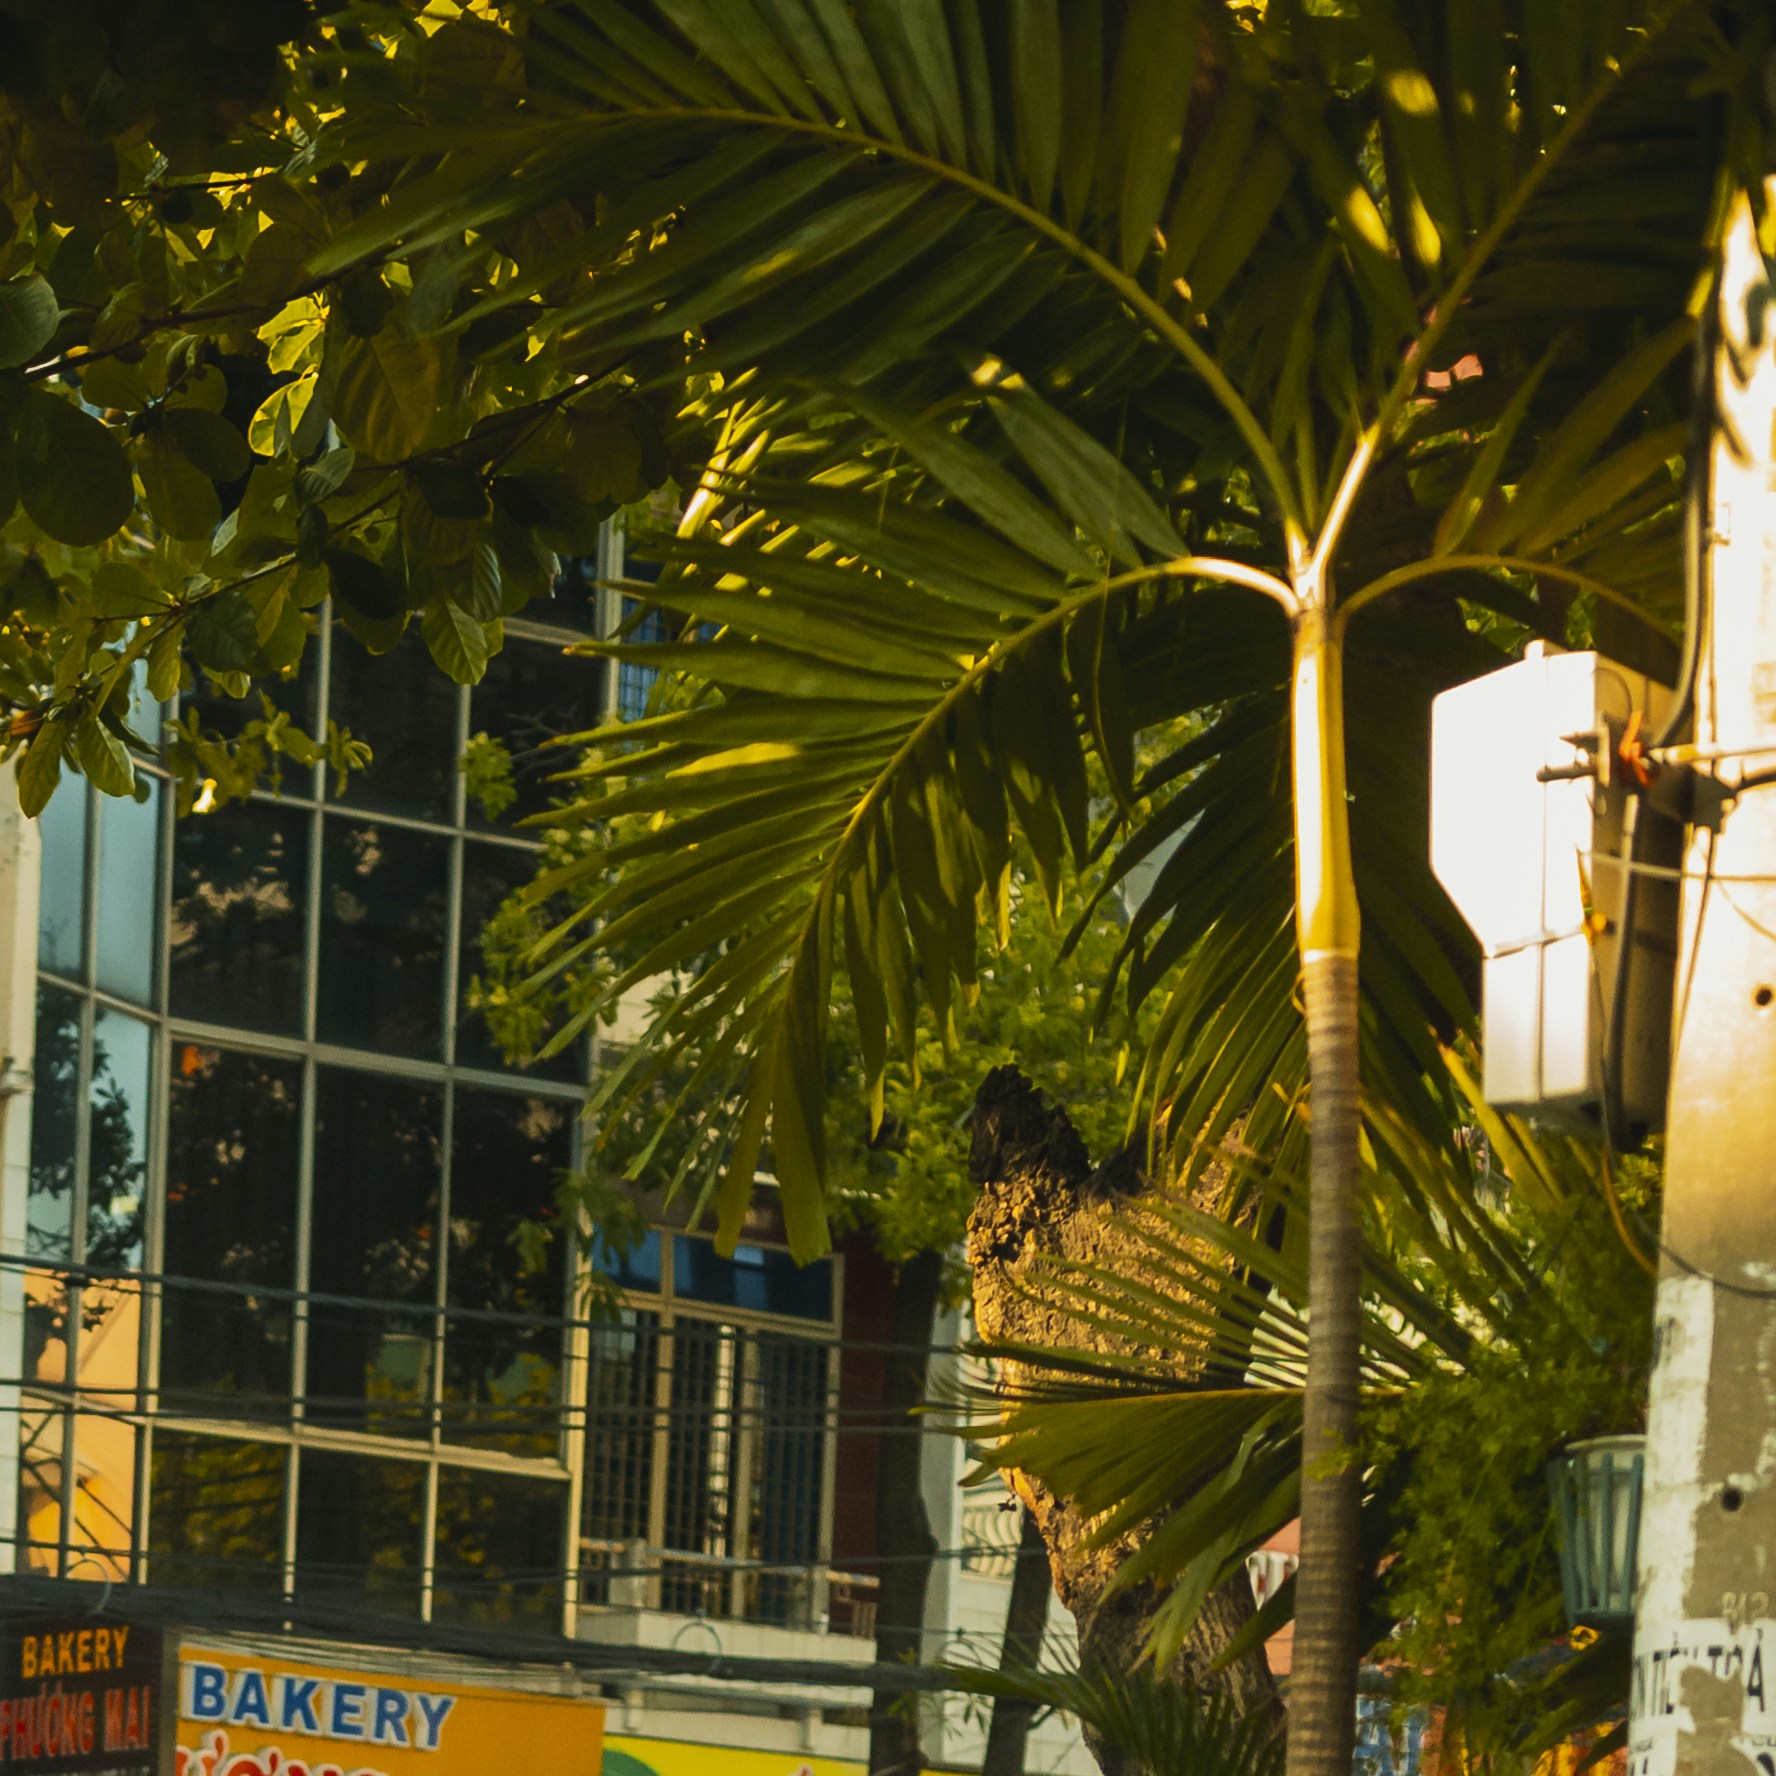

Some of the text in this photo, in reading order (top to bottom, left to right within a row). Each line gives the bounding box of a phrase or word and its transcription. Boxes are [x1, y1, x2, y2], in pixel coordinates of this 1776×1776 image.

[21, 1625, 129, 1678] BAKERY
[104, 1686, 152, 1752] MAI
[186, 1663, 457, 1751] BAKERY
